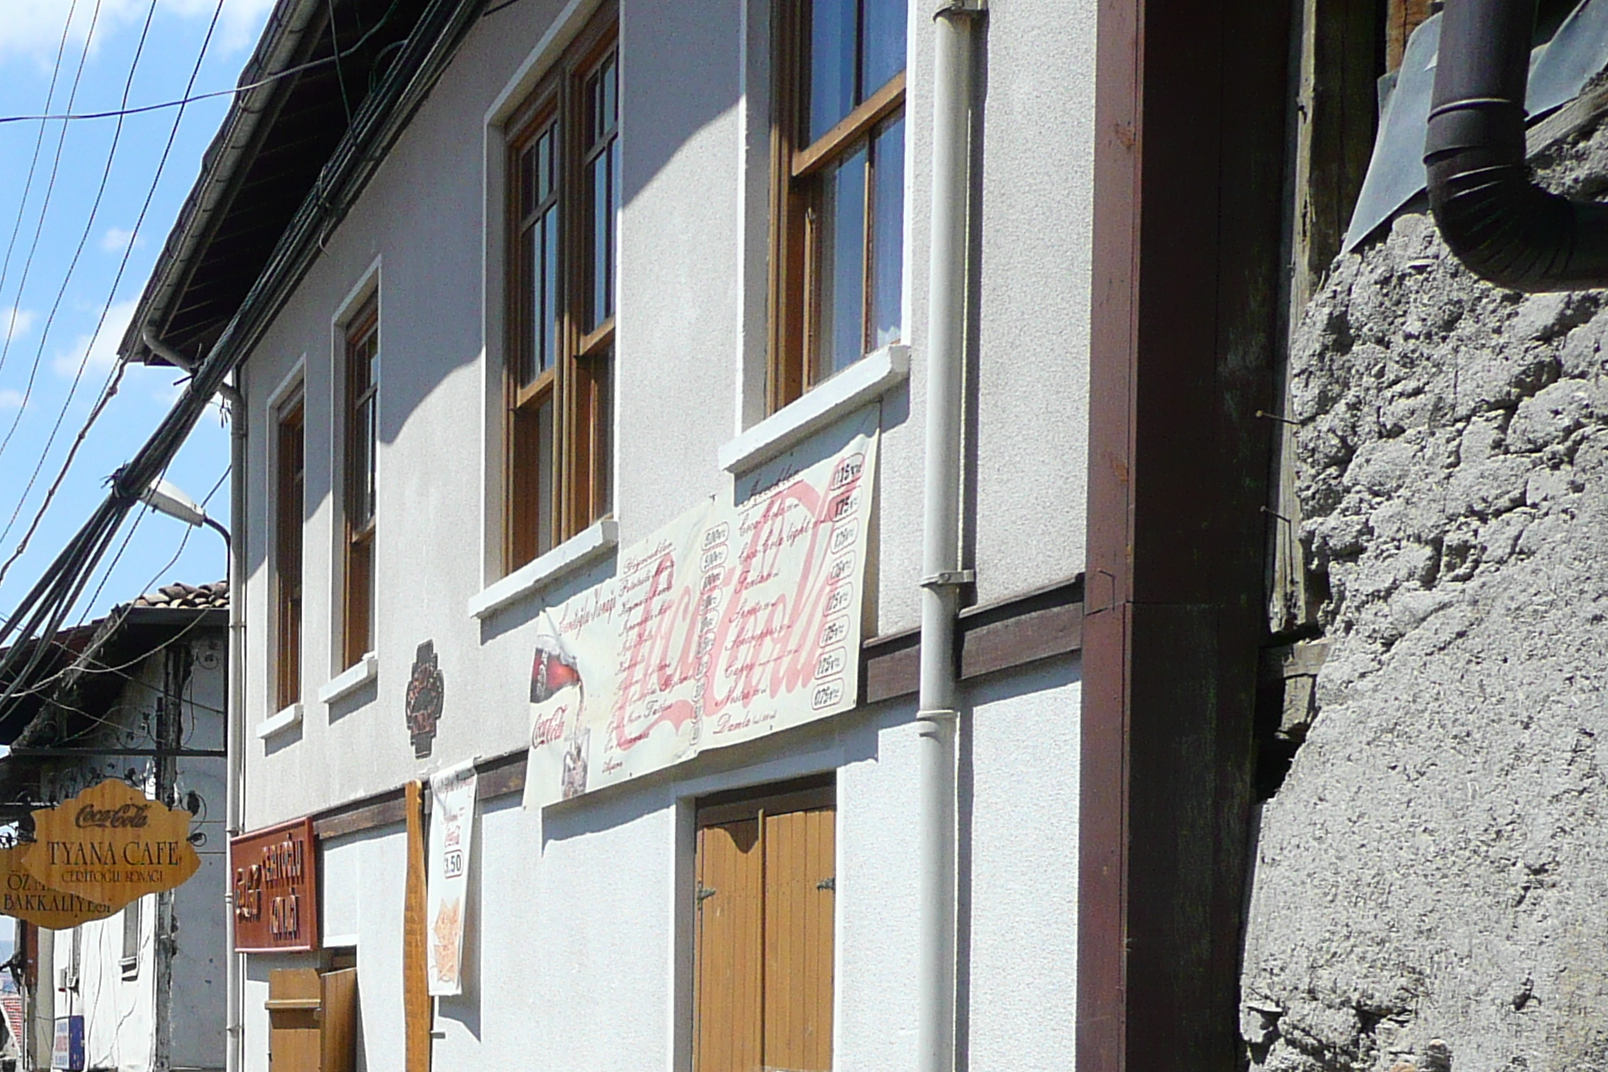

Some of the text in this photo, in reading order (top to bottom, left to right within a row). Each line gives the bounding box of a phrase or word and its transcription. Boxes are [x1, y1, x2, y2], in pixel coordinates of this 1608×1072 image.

[75, 803, 151, 828] Coca-Cola
[47, 841, 179, 866] TYANA CAFE
